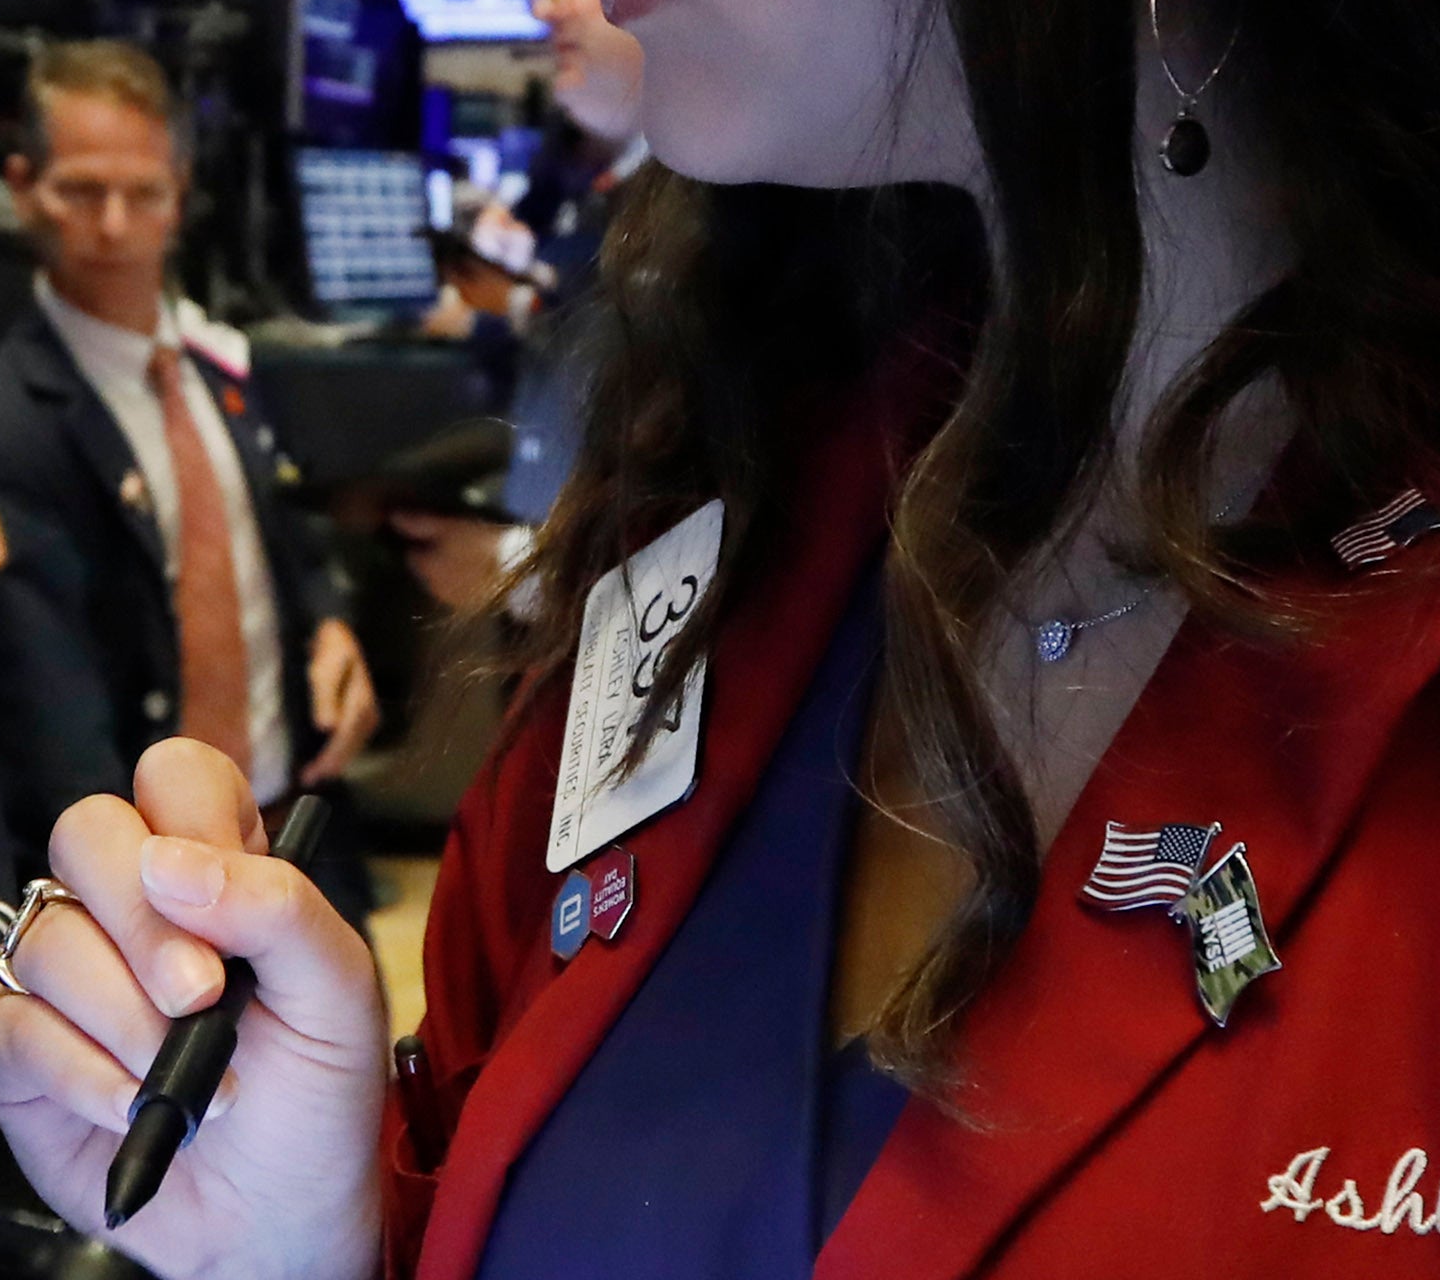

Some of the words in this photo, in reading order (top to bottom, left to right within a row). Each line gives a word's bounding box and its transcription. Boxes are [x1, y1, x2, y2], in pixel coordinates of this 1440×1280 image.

[605, 625, 630, 701] ASHLEY
[597, 710, 618, 768] LARA
[593, 876, 627, 904] EQUALITY
[1199, 915, 1227, 973] NYSE
